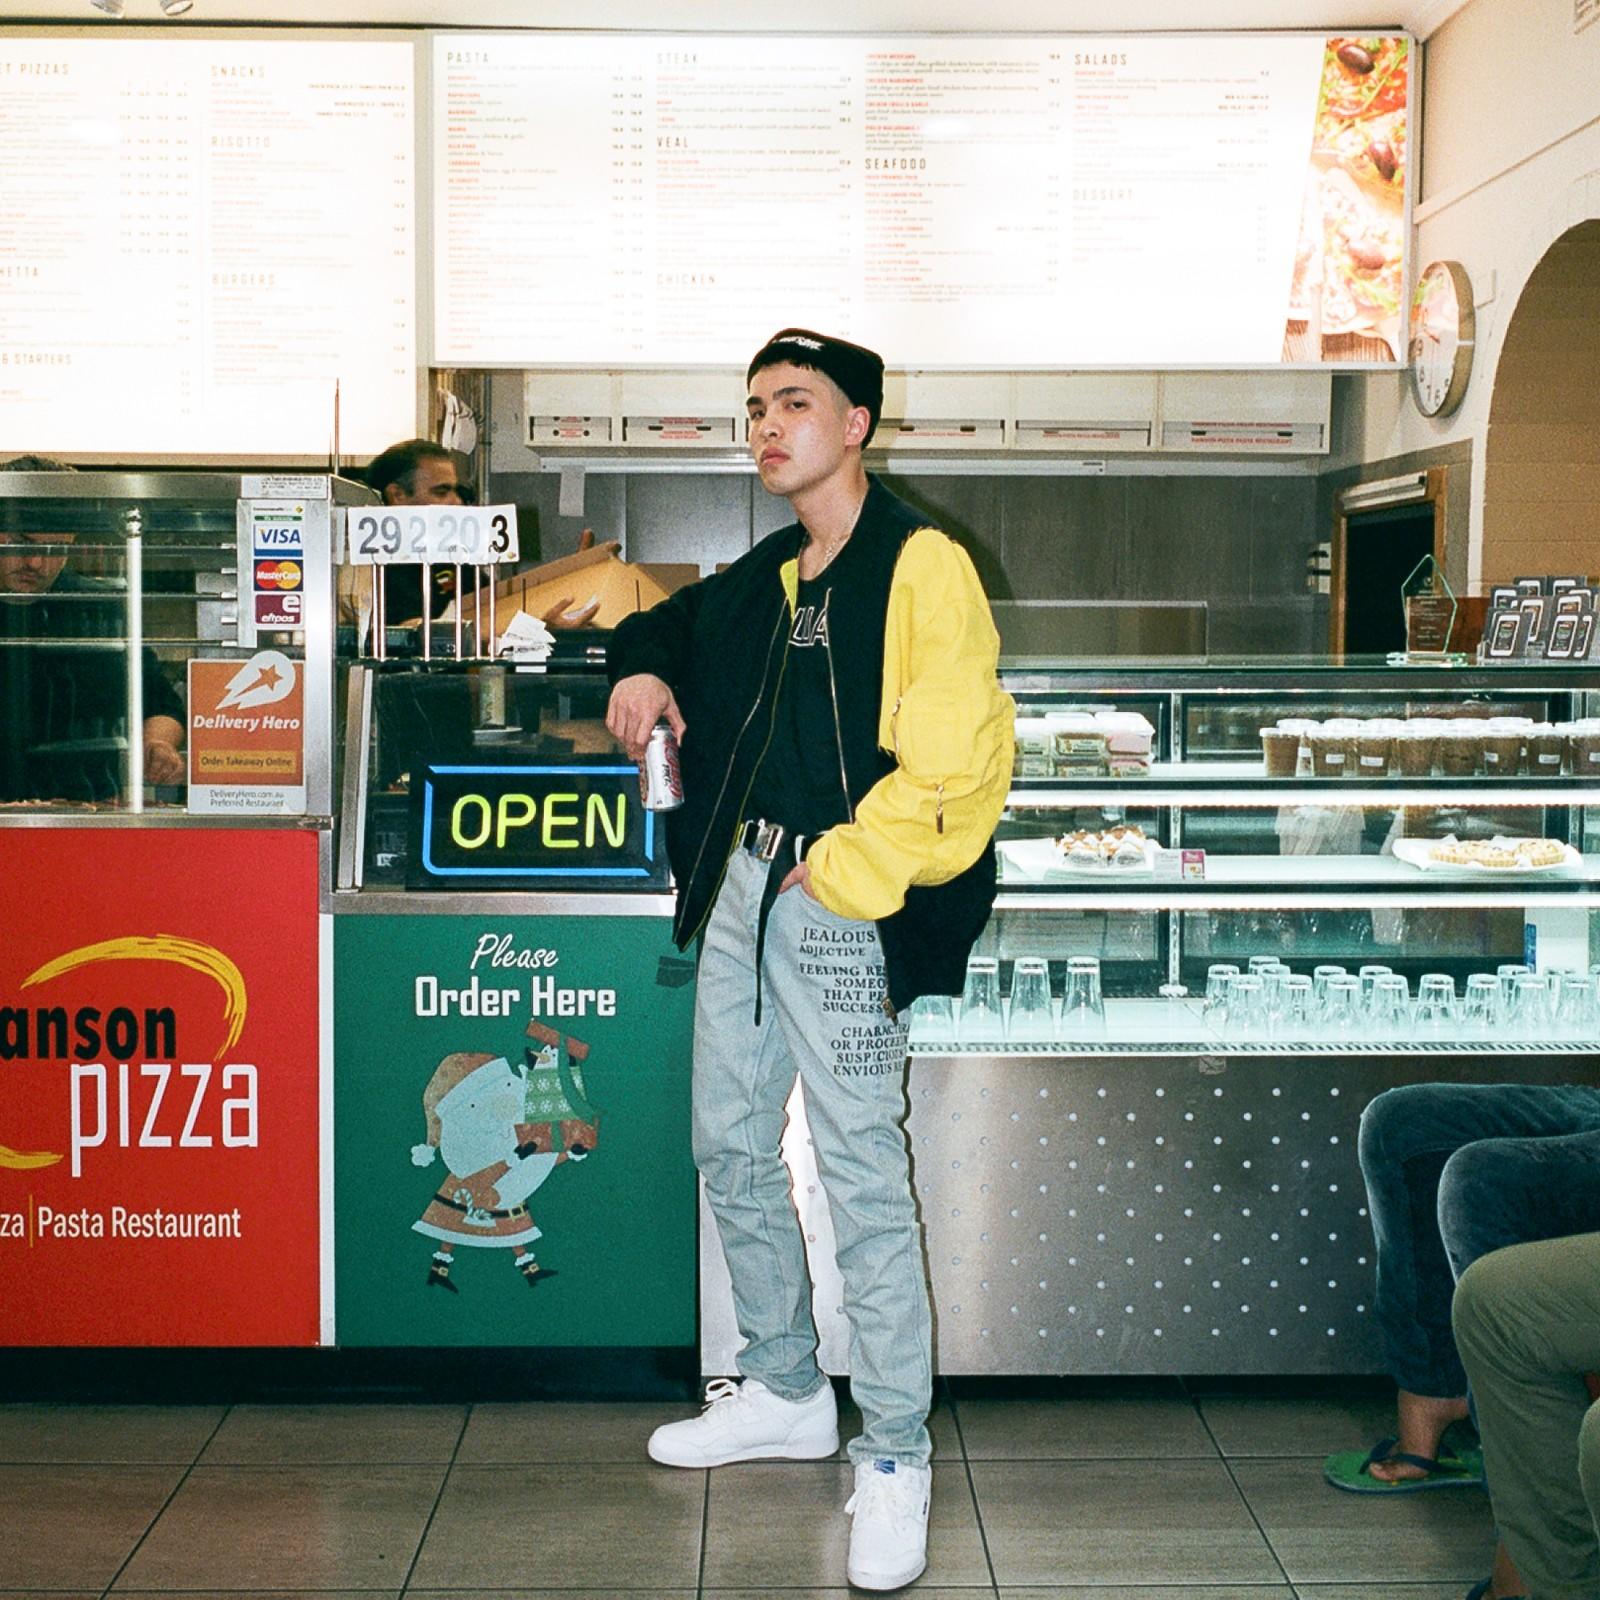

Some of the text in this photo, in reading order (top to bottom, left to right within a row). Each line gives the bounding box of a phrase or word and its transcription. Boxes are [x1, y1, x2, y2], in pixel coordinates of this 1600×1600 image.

[447, 52, 489, 63] PASTA
[656, 53, 698, 64] STEAK
[1074, 54, 1128, 66] SALADS
[19, 63, 70, 75] PIZZAS
[211, 136, 272, 148] RISOTTO
[656, 136, 689, 148] VEAL
[864, 158, 927, 170] SEAFOOD
[211, 273, 276, 286] BURGERS
[656, 273, 716, 285] CHICKEN
[14, 353, 73, 366] STARTERS
[260, 528, 301, 544] VISA
[358, 514, 510, 555] 29 2 20 3
[256, 570, 301, 582] MasterCard
[261, 613, 295, 624] eftpos
[193, 715, 300, 733] Delivery Hero
[201, 756, 292, 767] Order Takeaway Online
[210, 789, 285, 799] DeliveryHero.com.au
[210, 798, 284, 807] Preferred Restaurant
[451, 793, 626, 849] OPEN
[801, 927, 876, 944] JEALOUS
[470, 933, 559, 969] Please
[799, 945, 866, 957] ADJECTIVE
[800, 963, 861, 976] FEELING
[415, 976, 616, 1017] Order Here
[823, 989, 863, 1001] THAT
[822, 1002, 883, 1013] SUCCESS
[0, 1005, 177, 1060] anson
[831, 1039, 852, 1050] OR
[833, 1063, 893, 1076] ENVIOUS
[70, 1063, 259, 1177] pizza
[37, 1206, 103, 1238] Pasta
[112, 1206, 242, 1238] Restaurant
